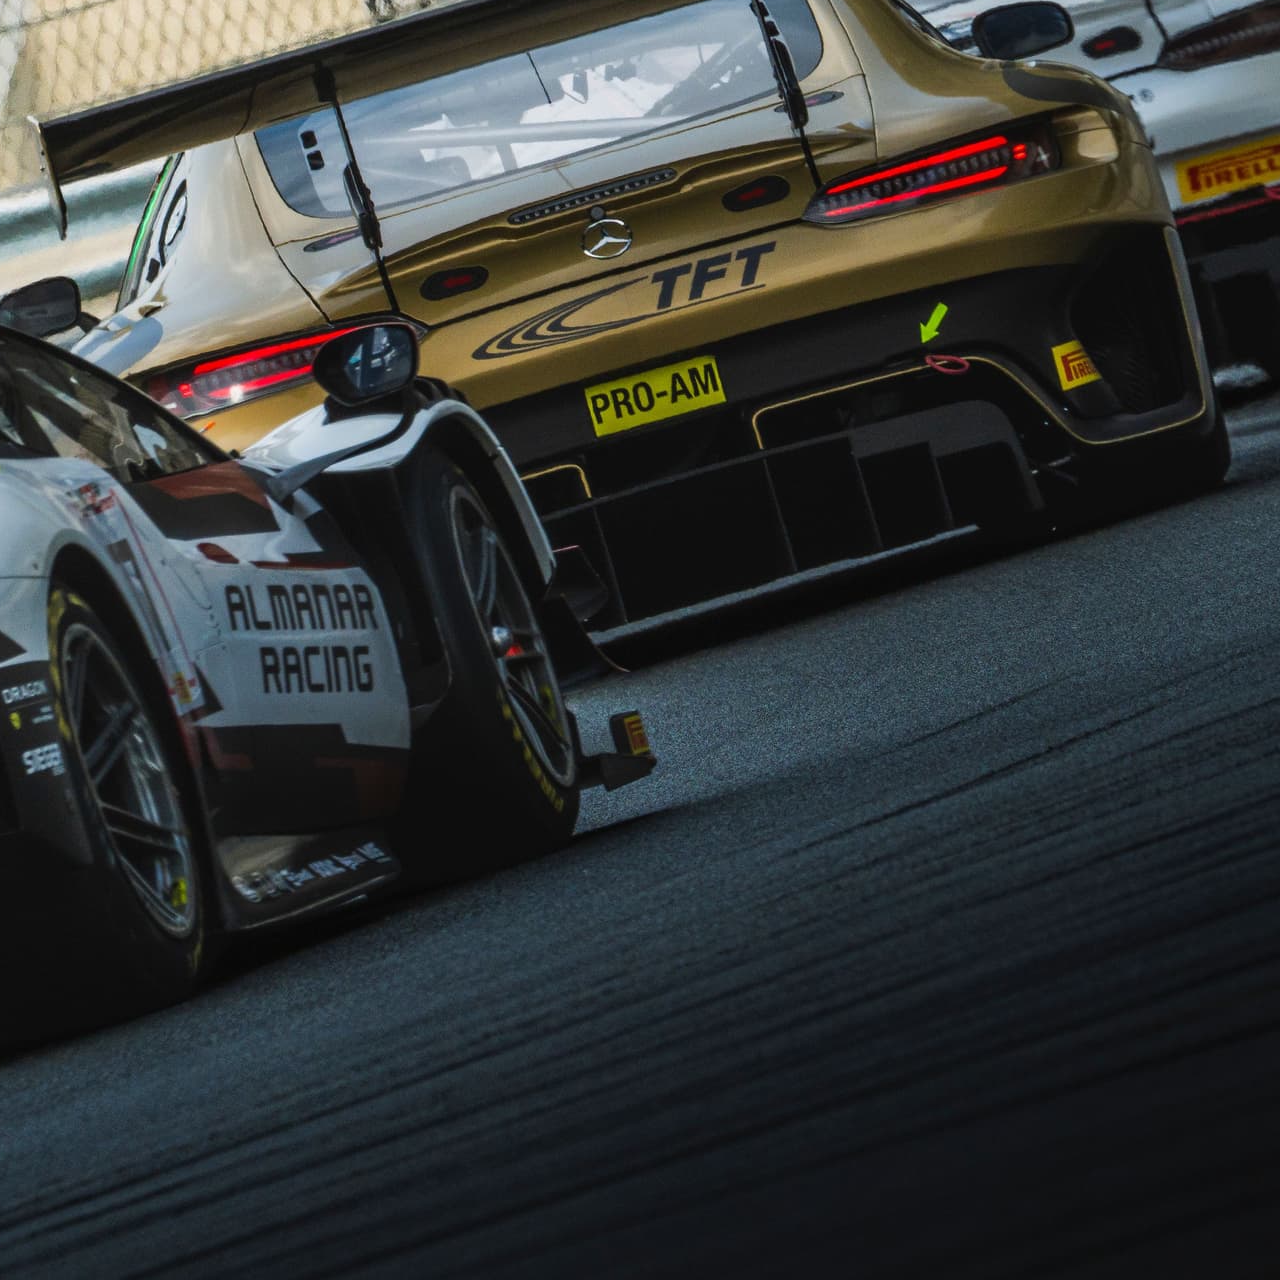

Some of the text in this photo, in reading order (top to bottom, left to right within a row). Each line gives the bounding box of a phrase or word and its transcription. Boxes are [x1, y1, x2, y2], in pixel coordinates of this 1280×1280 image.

[651, 241, 777, 311] TFT
[590, 363, 719, 425] PRO-AM
[225, 584, 380, 632] ALMANAR
[260, 645, 374, 694] RACING
